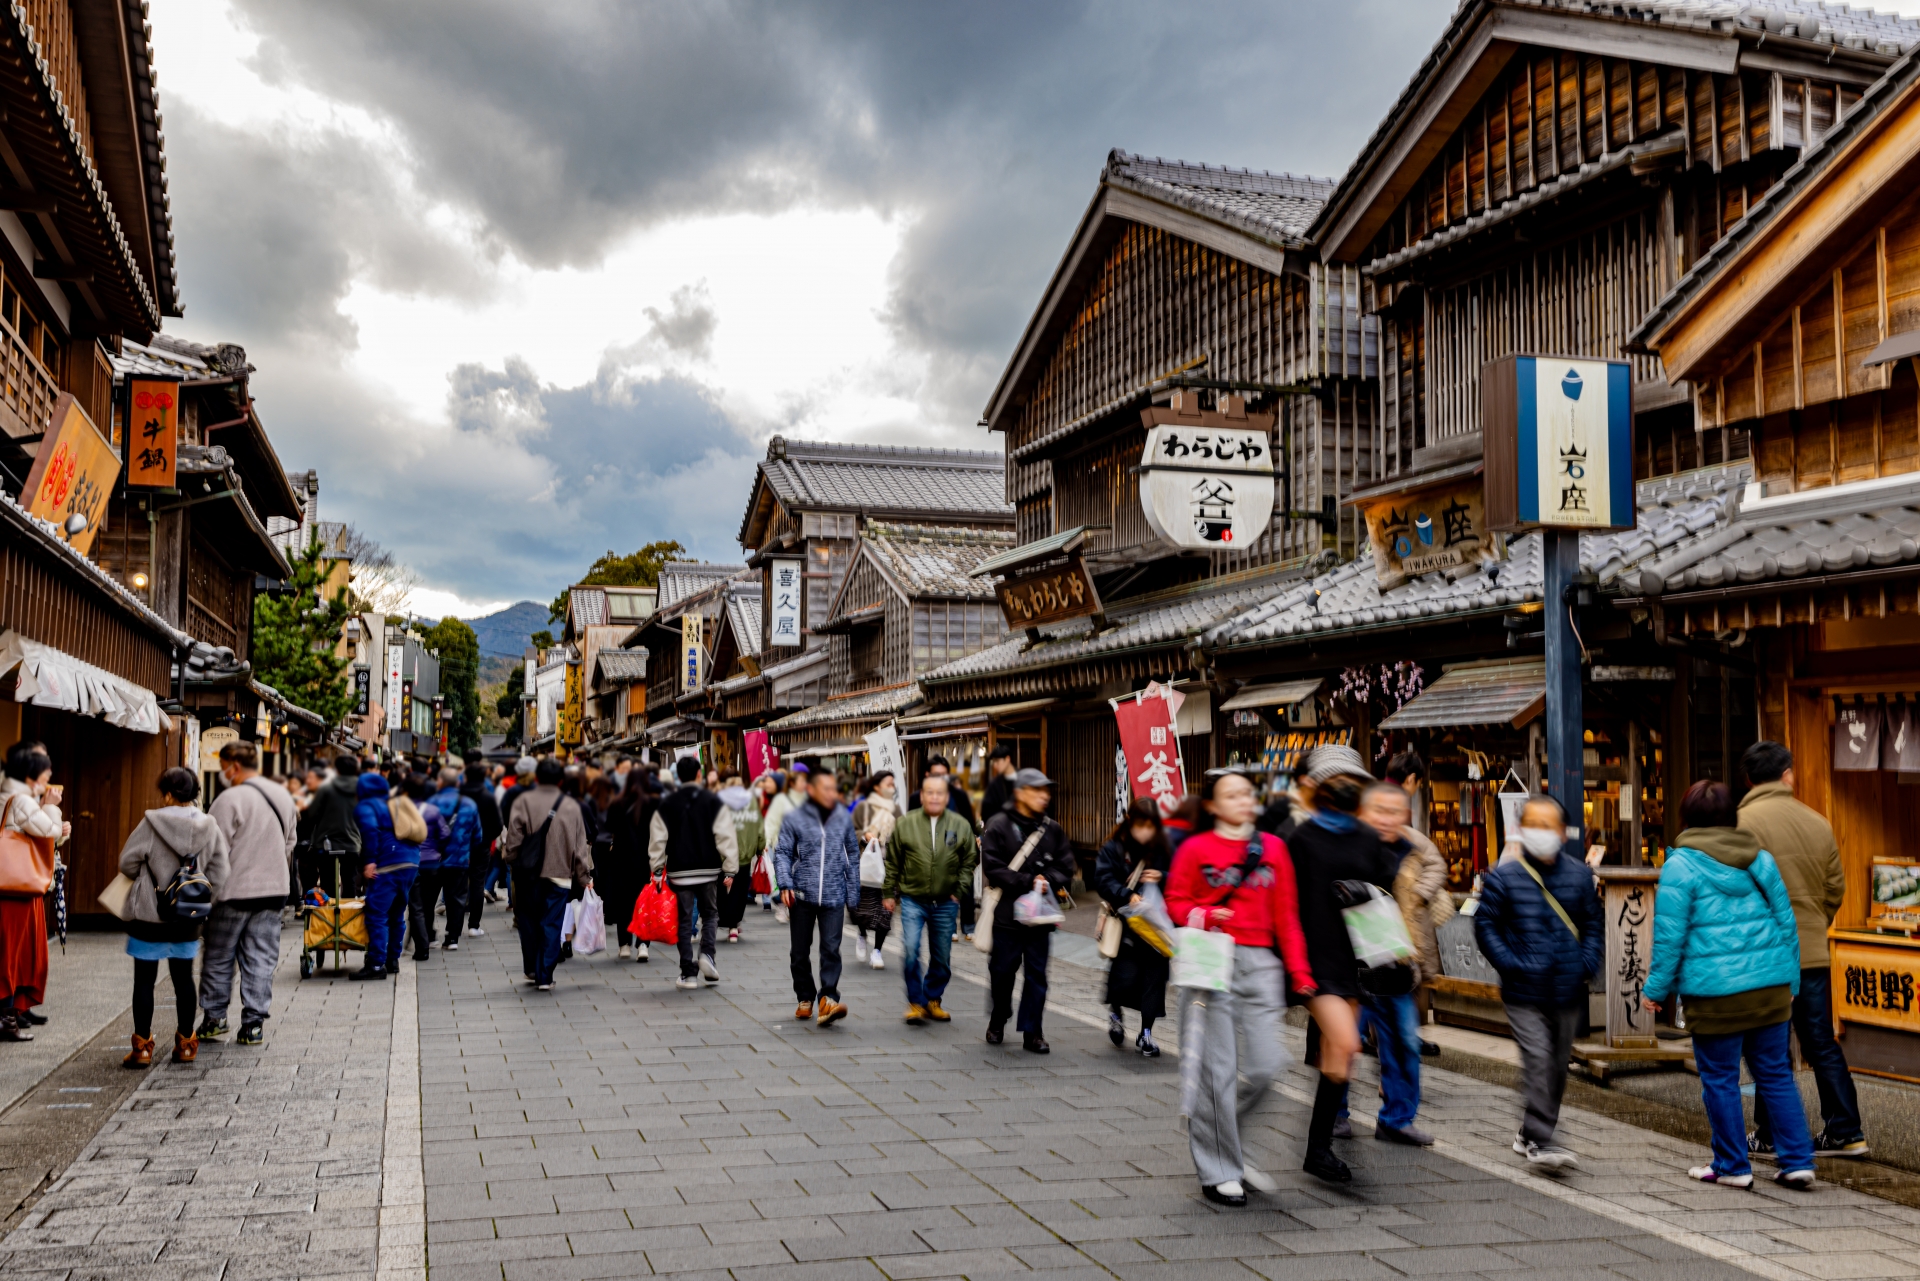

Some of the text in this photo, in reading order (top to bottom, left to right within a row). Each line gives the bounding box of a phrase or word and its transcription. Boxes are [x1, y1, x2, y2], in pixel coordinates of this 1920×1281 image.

[133, 418, 168, 473] 牛鍋
[1162, 433, 1263, 460] わらじや
[1409, 553, 1457, 571] IWAKURA
[775, 567, 797, 637] 喜久屋
[1029, 572, 1084, 615] わらじや
[1845, 964, 1920, 1013] 熊野
